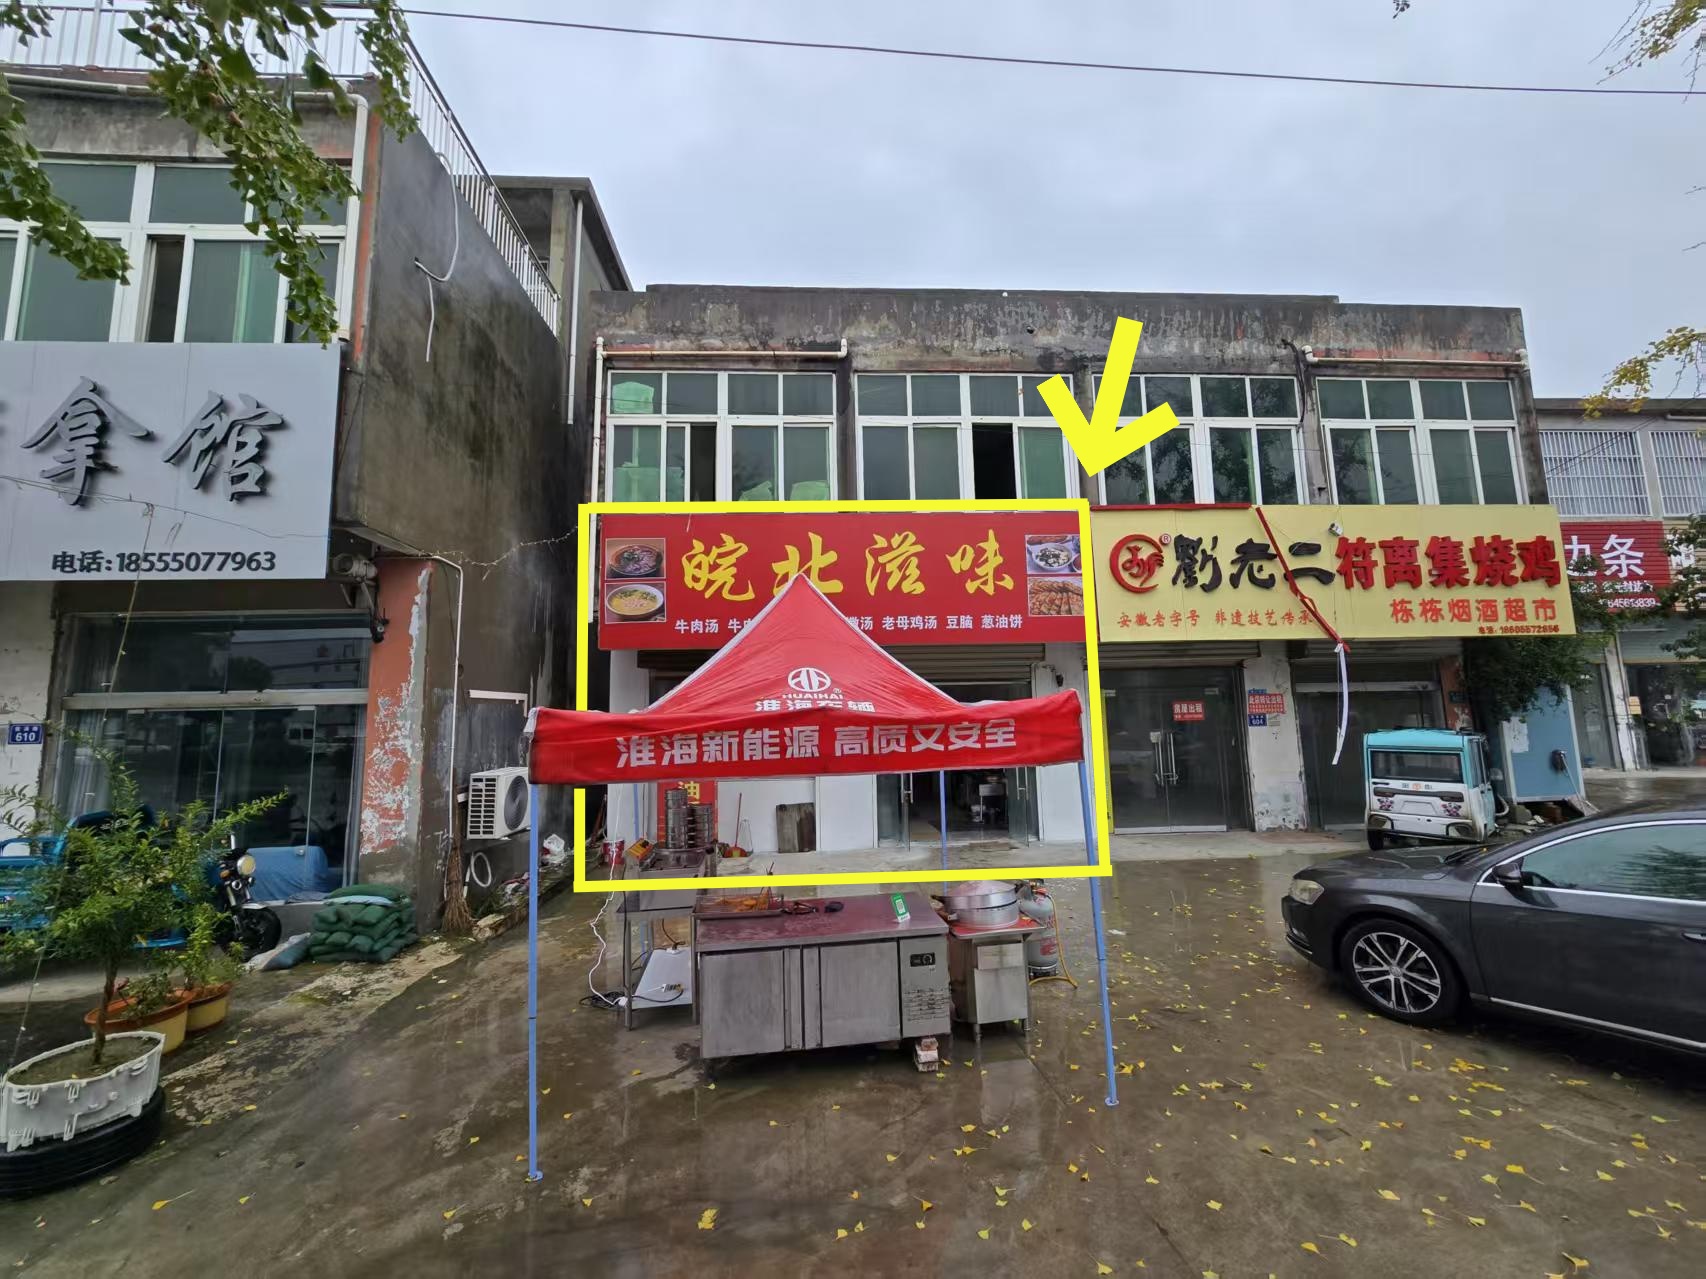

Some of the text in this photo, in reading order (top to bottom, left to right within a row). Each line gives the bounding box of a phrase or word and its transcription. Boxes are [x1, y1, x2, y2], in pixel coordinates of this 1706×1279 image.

[20, 376, 284, 506] 拿馆
[681, 529, 1014, 602] 皖北滋味
[1335, 535, 1561, 590] 符离集烧鸡
[674, 620, 719, 634] 牛肉汤
[881, 615, 937, 630] 老母鸡汤
[981, 614, 1023, 629] 葱油饼
[1117, 609, 1201, 628] 安徽老字号
[1389, 598, 1557, 623] 栋栋烟酒超市
[15, 732, 36, 741] 610
[616, 718, 1017, 768] 淮海新能源 高质又安全
